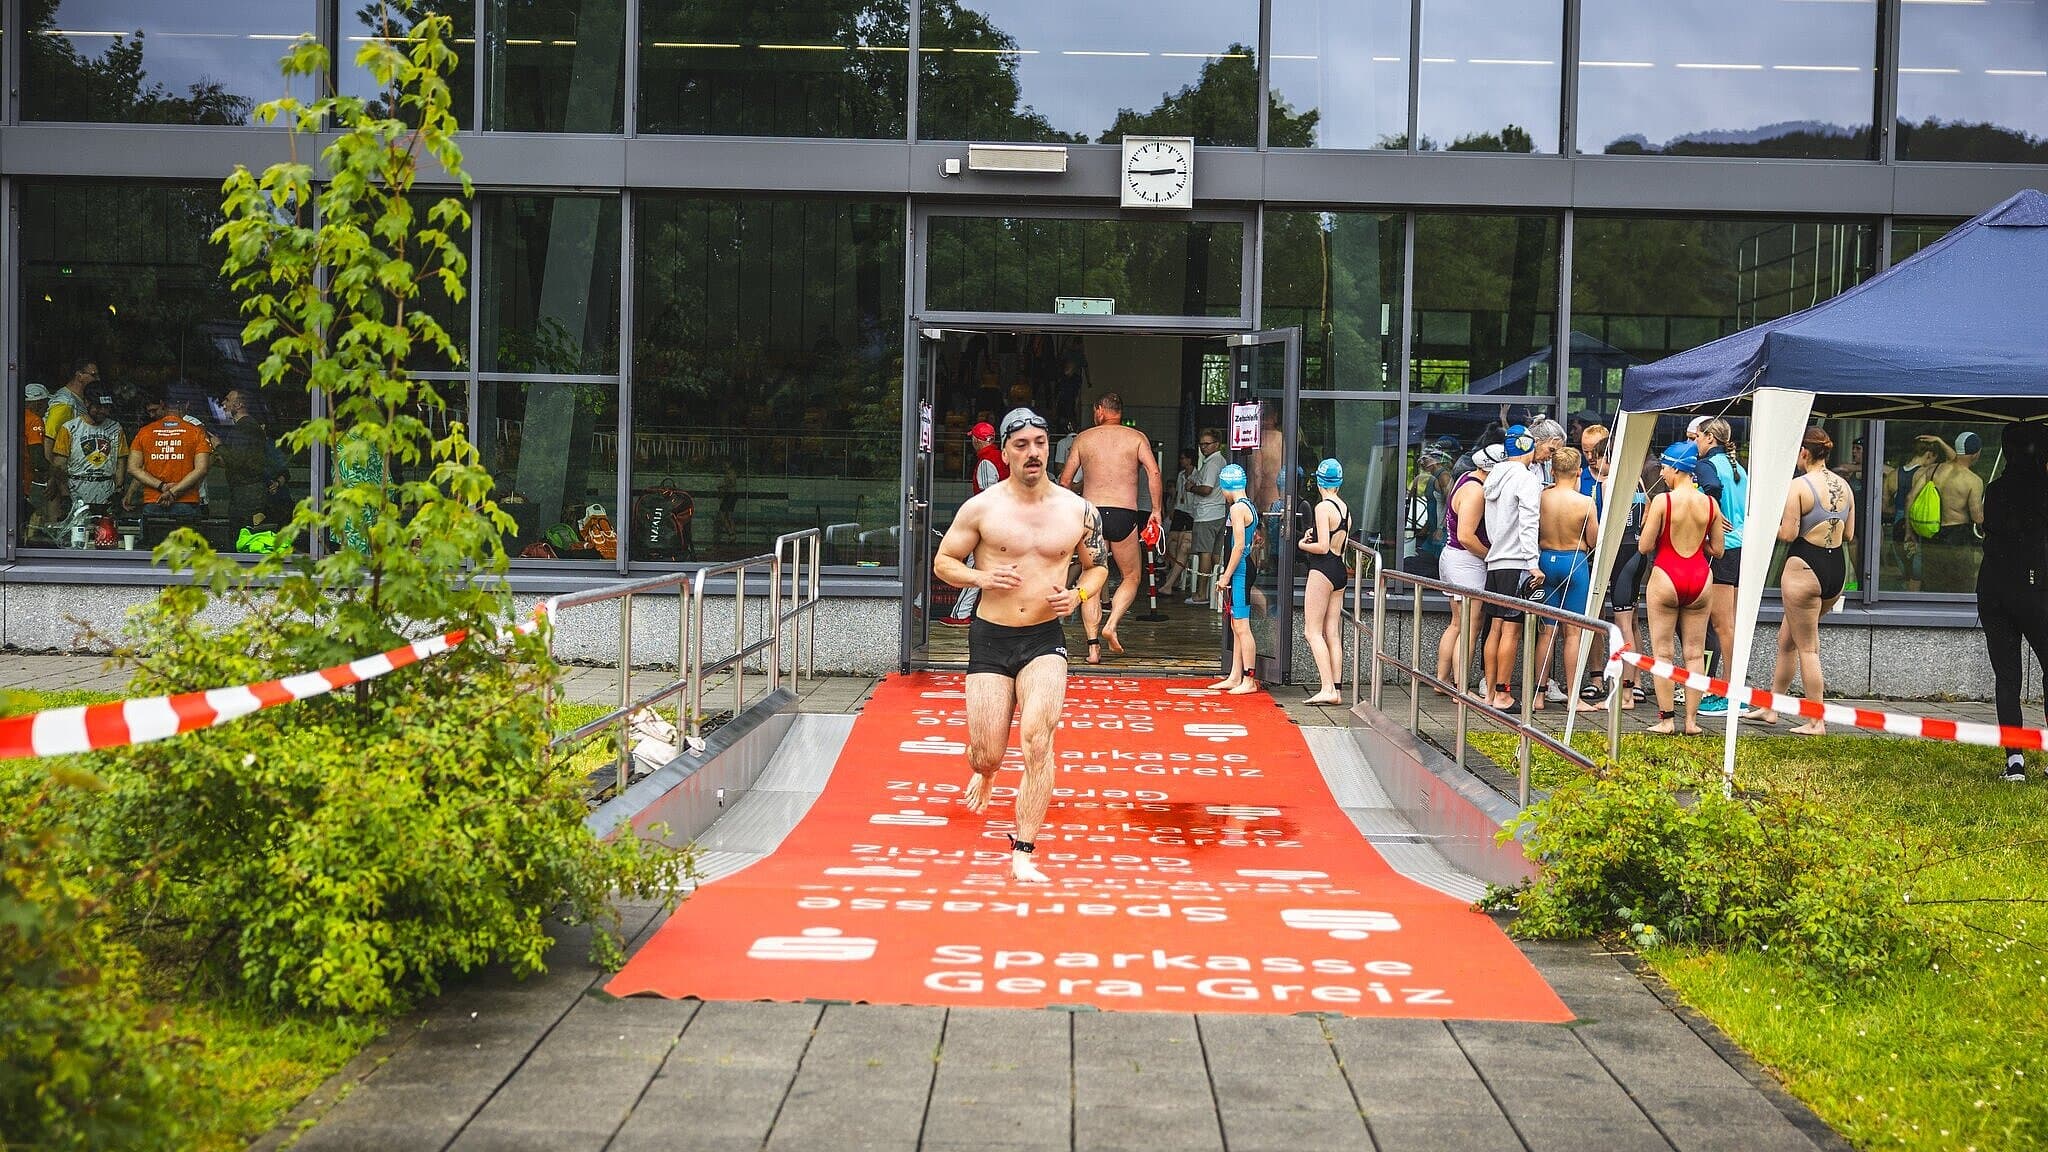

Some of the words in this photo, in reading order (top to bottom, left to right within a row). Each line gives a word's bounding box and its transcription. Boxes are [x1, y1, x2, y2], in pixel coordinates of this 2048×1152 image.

[1004, 746, 1249, 763] Sarkasse
[1000, 760, 1264, 778] Gra-Greiz
[886, 781, 1168, 801] GeraGeiz
[892, 795, 1171, 812] Sparasse
[849, 844, 1190, 867] GeraGreiz
[797, 896, 1227, 922] Sparkasse
[930, 944, 1414, 976] Sparkasse
[923, 971, 1454, 1004] Gera-Greiz
